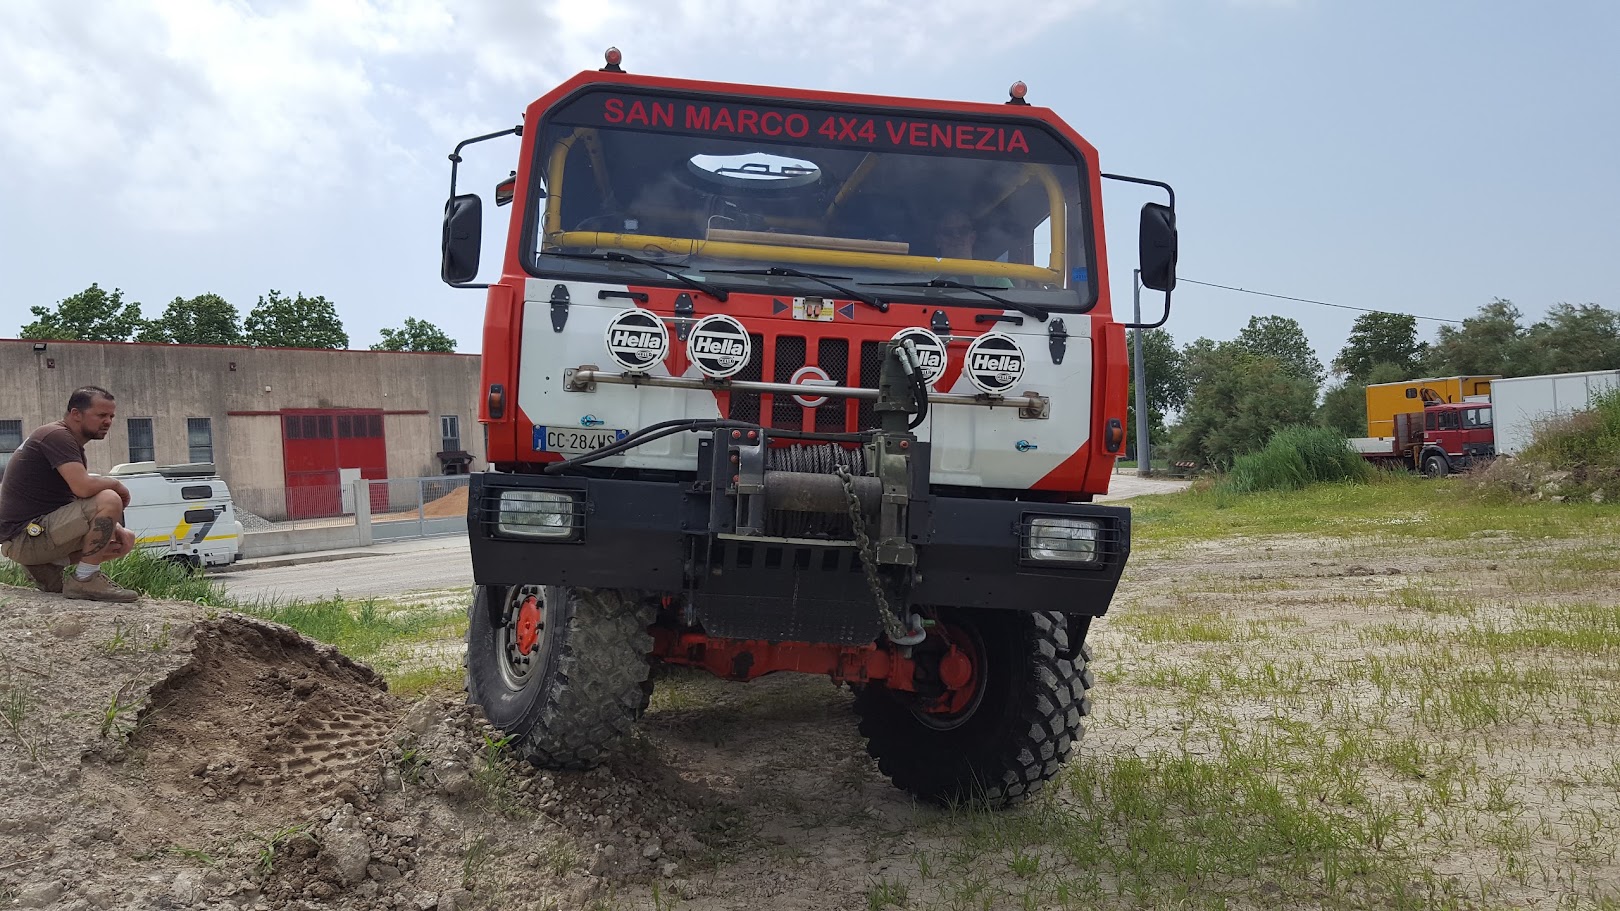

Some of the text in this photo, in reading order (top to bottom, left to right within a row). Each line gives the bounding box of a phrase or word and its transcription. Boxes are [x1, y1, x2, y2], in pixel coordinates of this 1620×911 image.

[604, 98, 1030, 154] SAN MARCO 4X4 VENEZIA
[612, 331, 661, 349] Hella
[695, 337, 744, 356] Hella
[918, 350, 940, 366] lla
[973, 354, 1021, 372] Hella
